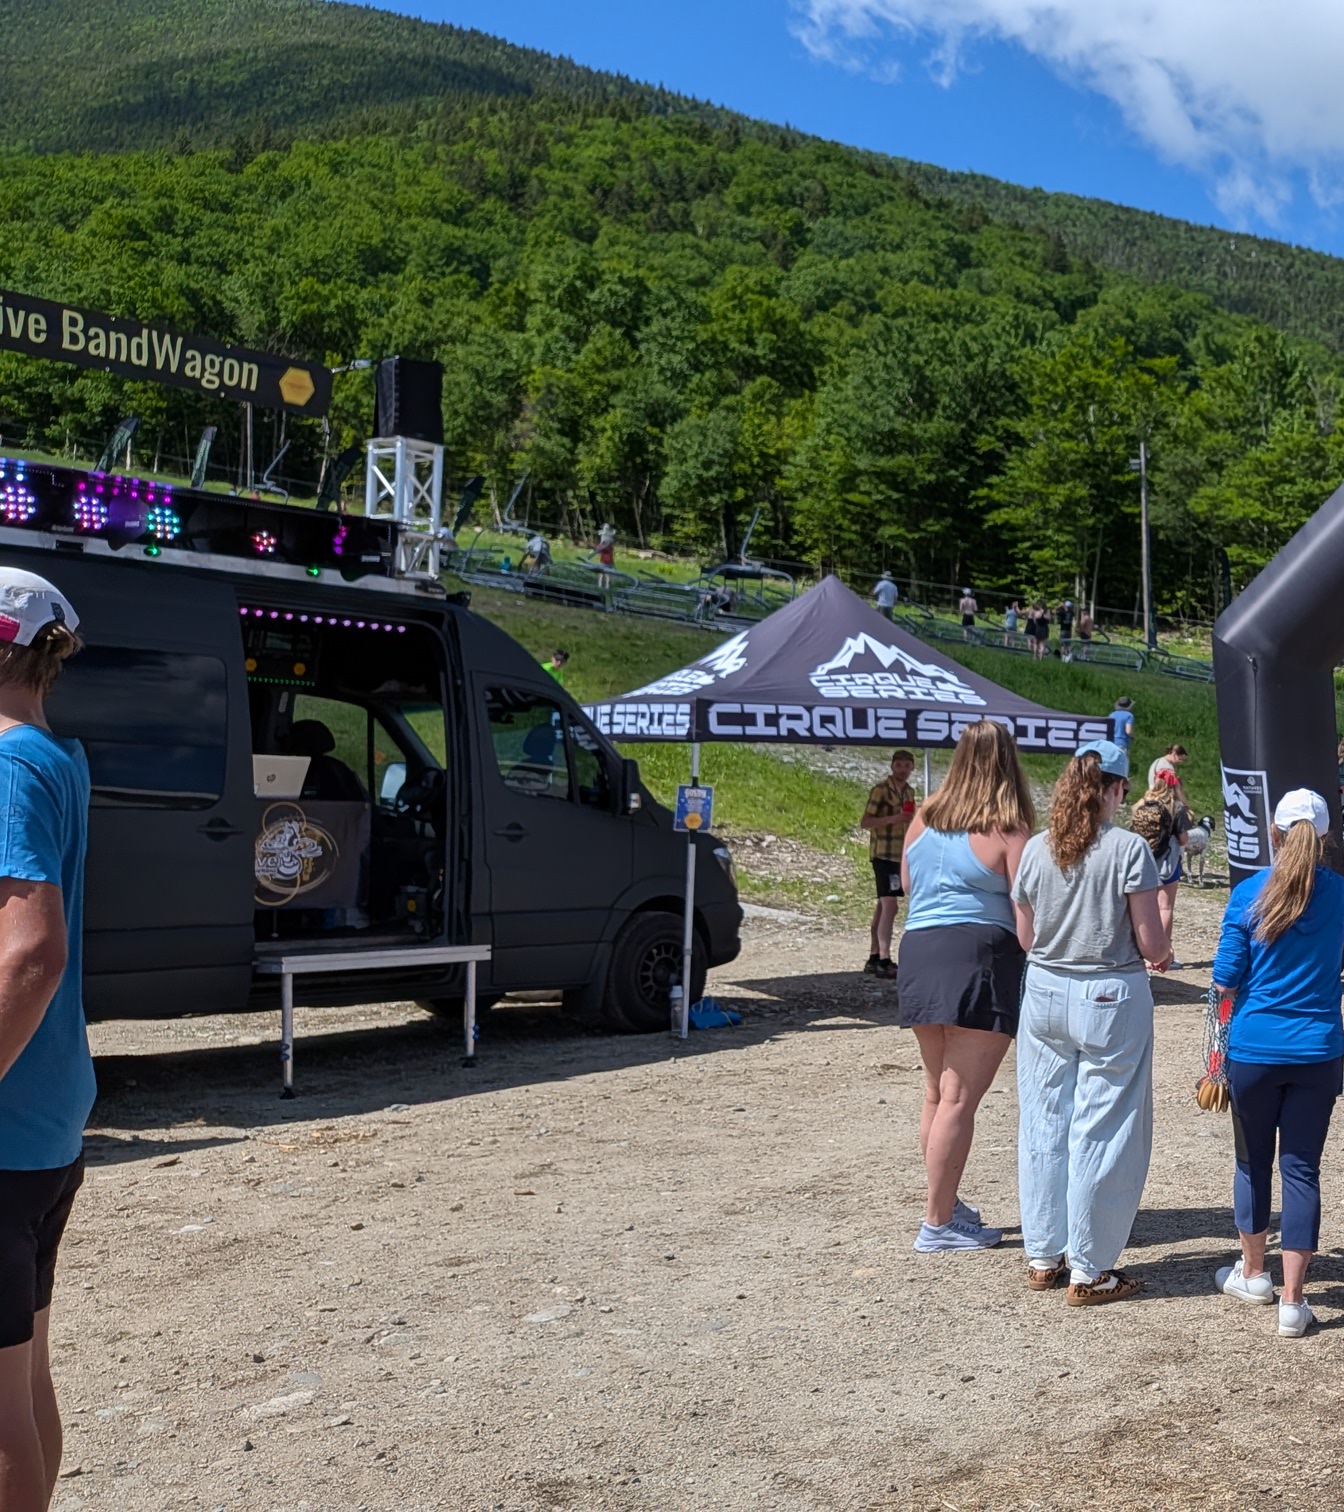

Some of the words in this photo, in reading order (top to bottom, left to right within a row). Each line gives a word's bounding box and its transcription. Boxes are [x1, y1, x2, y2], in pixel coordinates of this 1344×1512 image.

[62, 309, 259, 391] BandWagon
[809, 672, 937, 690] CIRQUE
[818, 686, 987, 706] SERIES
[612, 703, 691, 736] SERIES
[709, 703, 907, 739] CIRQUE
